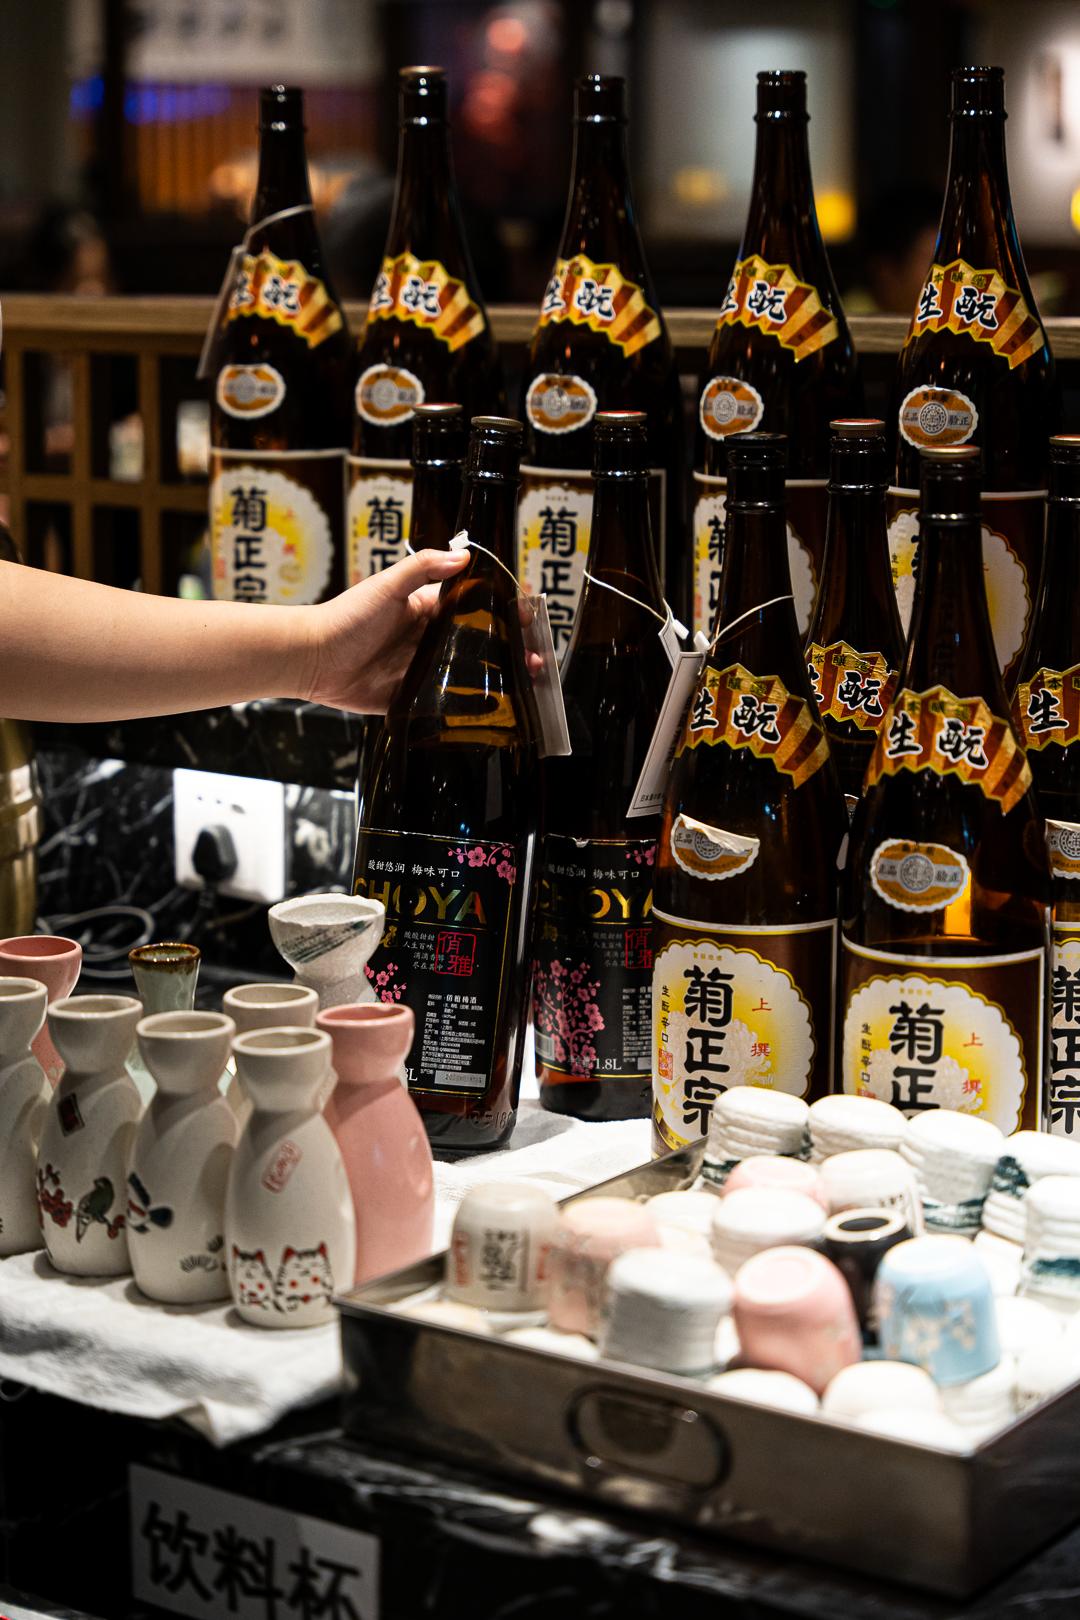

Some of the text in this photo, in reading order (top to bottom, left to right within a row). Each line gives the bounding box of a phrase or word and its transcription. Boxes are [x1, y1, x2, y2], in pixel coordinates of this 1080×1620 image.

[917, 283, 998, 330] 生酛
[690, 687, 781, 744] 生酛
[886, 711, 989, 769] 生酛
[368, 859, 460, 878] 酸甜悠润 梅味可口
[683, 965, 735, 1136] 菊正宗
[889, 1001, 945, 1111] 菊正
[141, 1500, 362, 1620] 饮料杯
